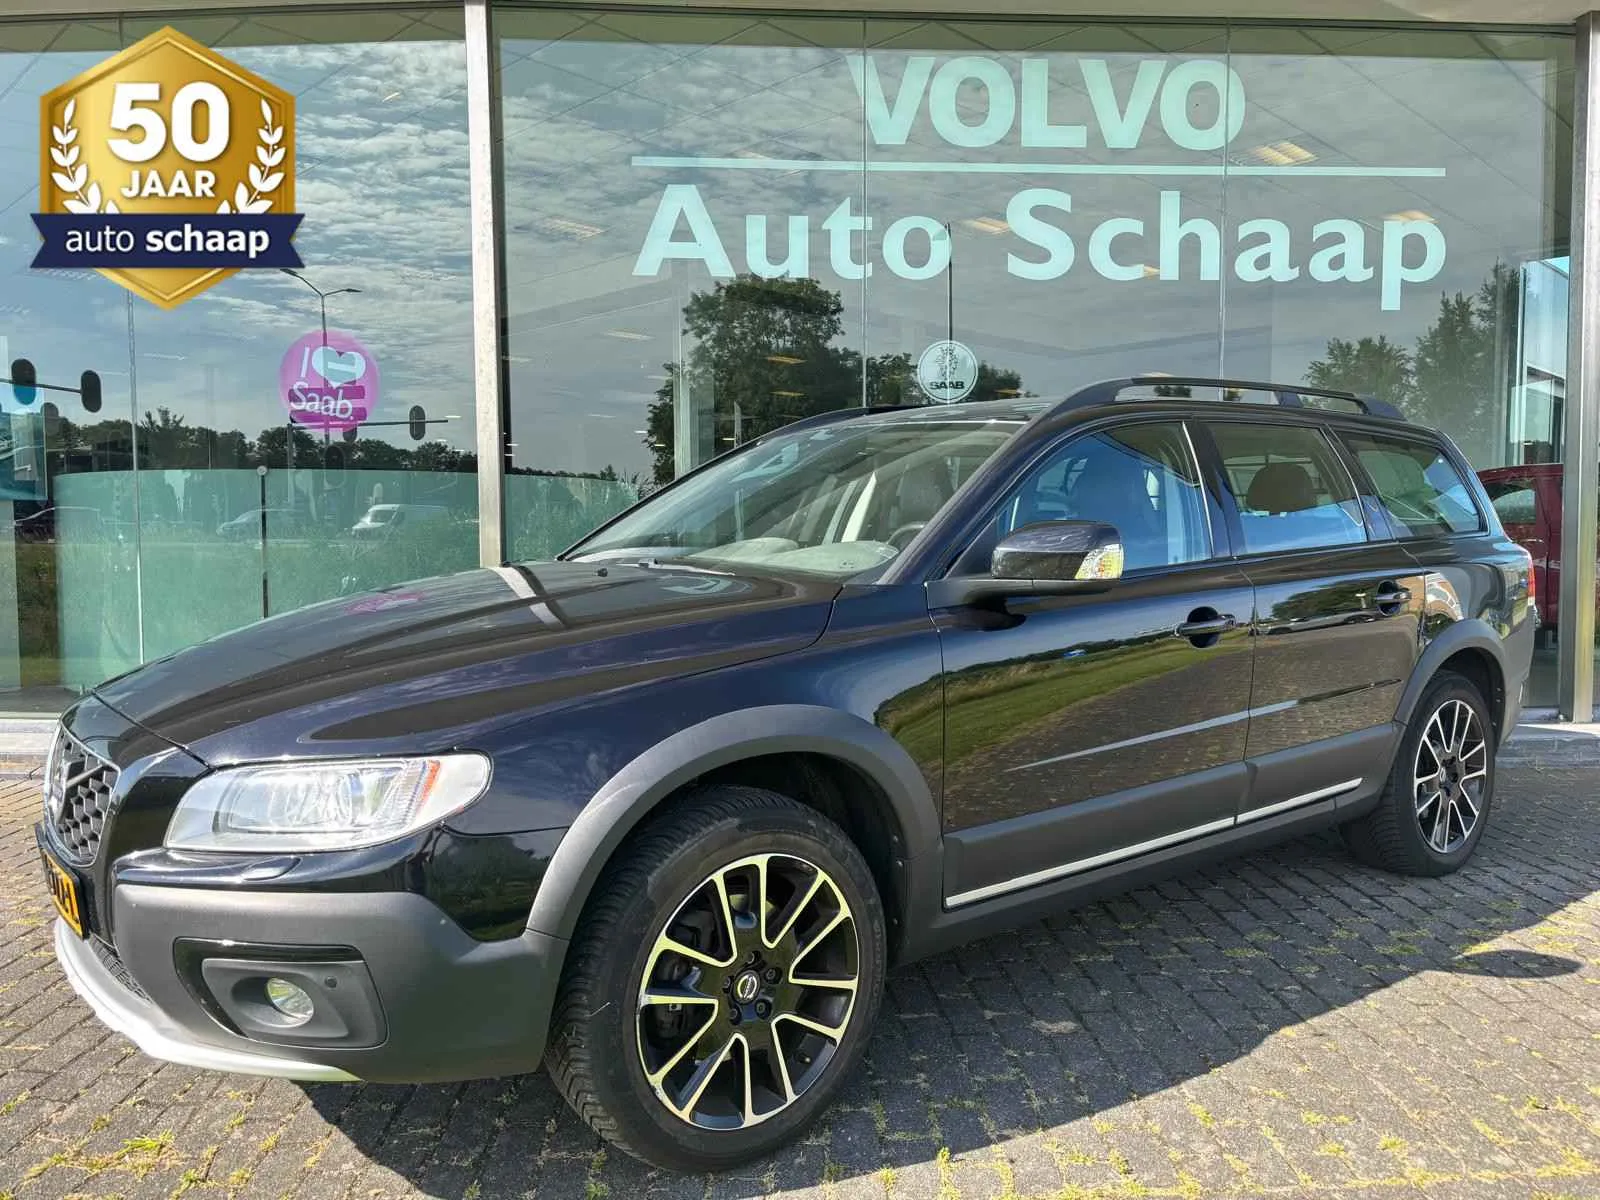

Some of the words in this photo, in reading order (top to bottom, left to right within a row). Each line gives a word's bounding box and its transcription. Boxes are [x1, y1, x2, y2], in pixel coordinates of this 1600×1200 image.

[847, 56, 1246, 151] VOLVO
[631, 184, 953, 280] Auto
[1005, 188, 1447, 311] Schaap
[929, 380, 965, 390] SAAB
